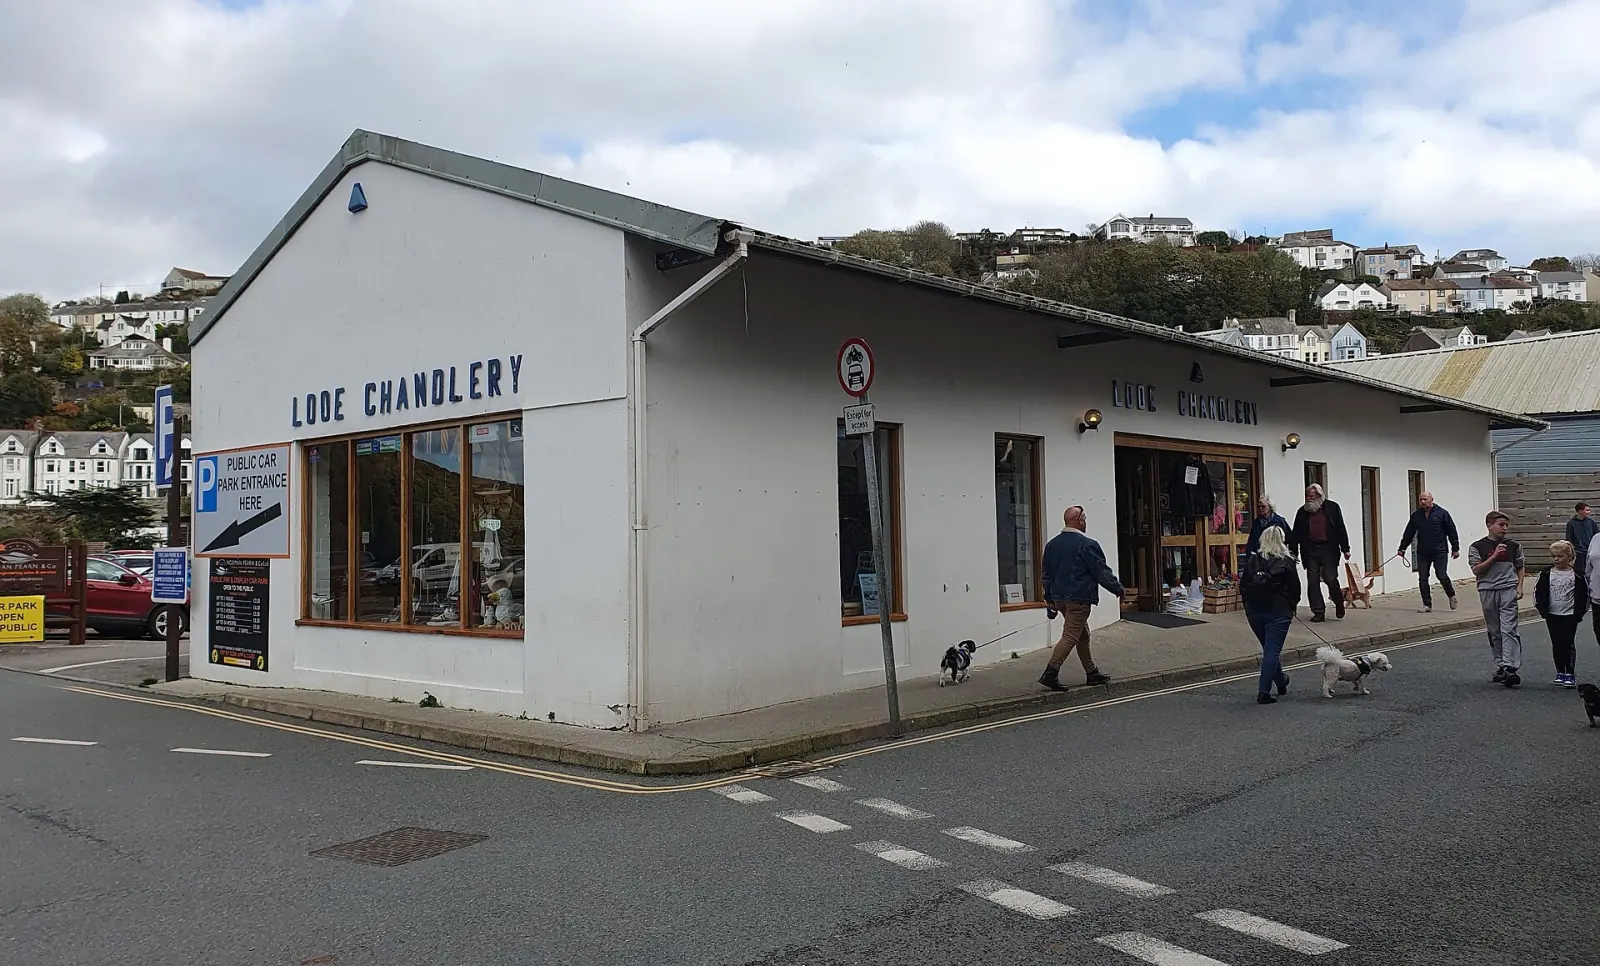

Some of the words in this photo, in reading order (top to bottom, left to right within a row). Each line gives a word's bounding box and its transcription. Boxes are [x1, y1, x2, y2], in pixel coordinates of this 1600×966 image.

[292, 387, 345, 427] LOOE
[364, 354, 523, 417] CHANDLERY
[1112, 379, 1157, 412] LOOE
[1178, 390, 1258, 426] CHANDLERY
[846, 408, 864, 420] Except
[852, 421, 868, 429] access
[227, 455, 257, 472] PUBLIC
[258, 453, 277, 468] CAR
[198, 459, 216, 511] P
[218, 477, 239, 492] PARK
[241, 473, 288, 490] ENTRANCE
[239, 495, 262, 510] HERE
[8, 602, 37, 610] PARK
